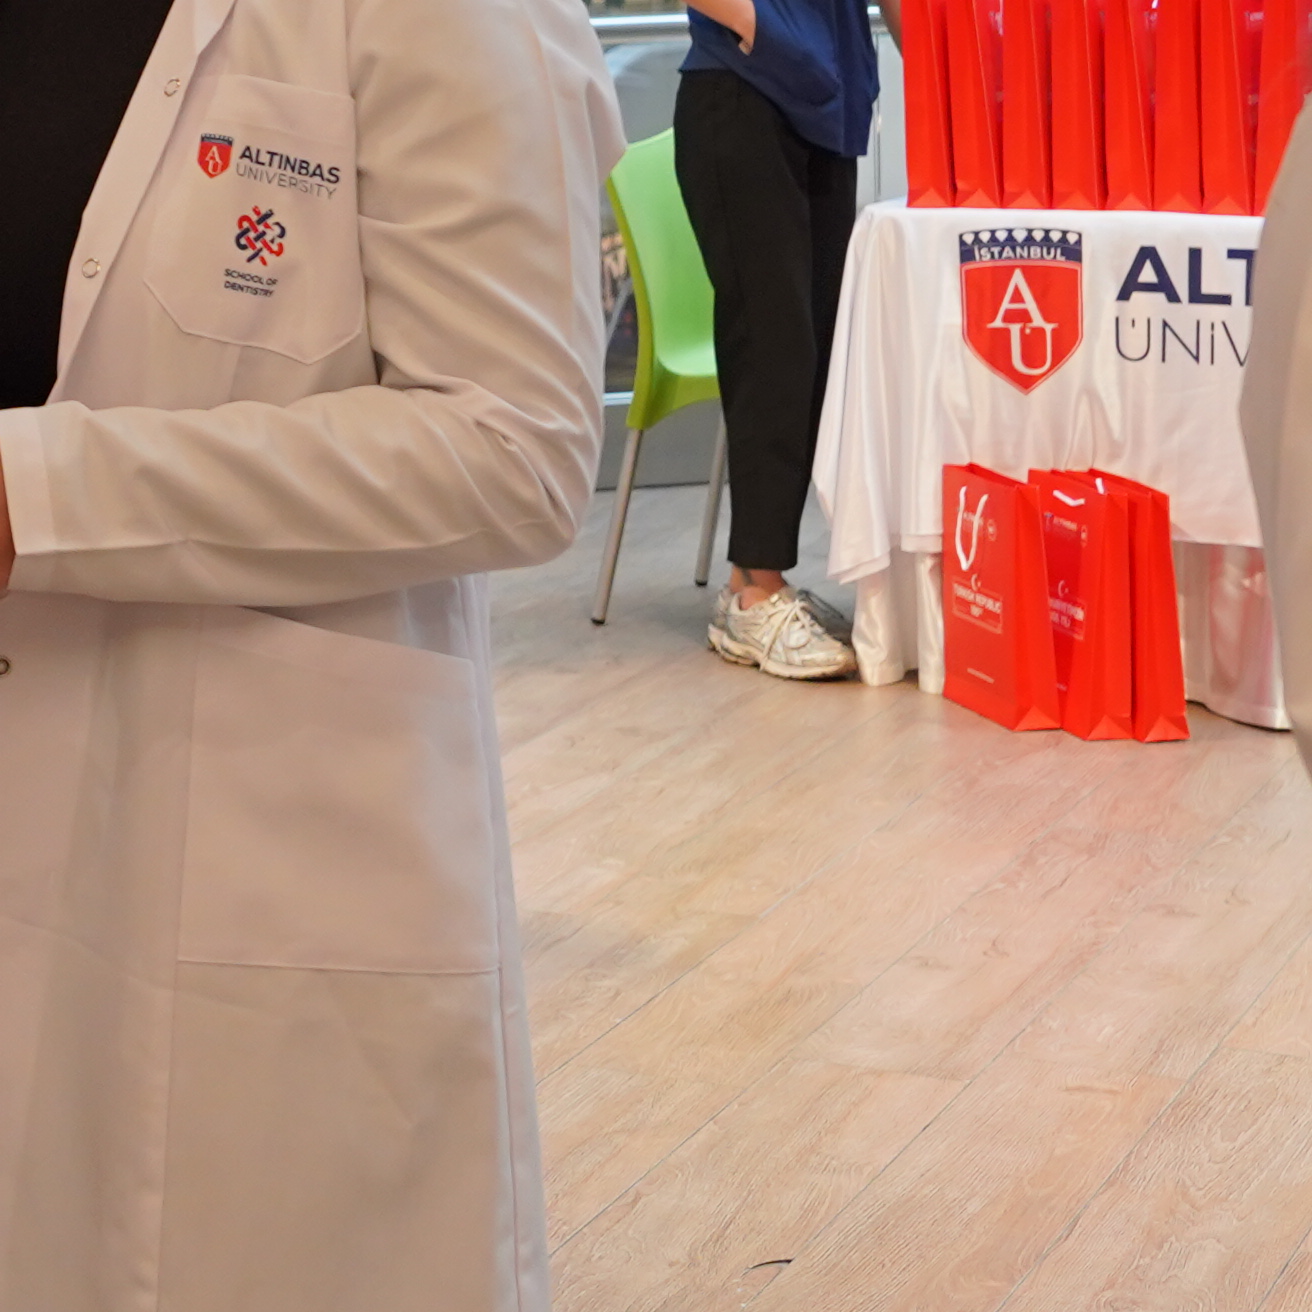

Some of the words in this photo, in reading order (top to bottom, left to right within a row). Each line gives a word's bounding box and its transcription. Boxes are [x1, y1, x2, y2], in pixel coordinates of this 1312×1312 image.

[236, 162, 337, 200] UNIVERSITY
[224, 268, 264, 285] SCHOOL
[1115, 245, 1256, 307] ALT
